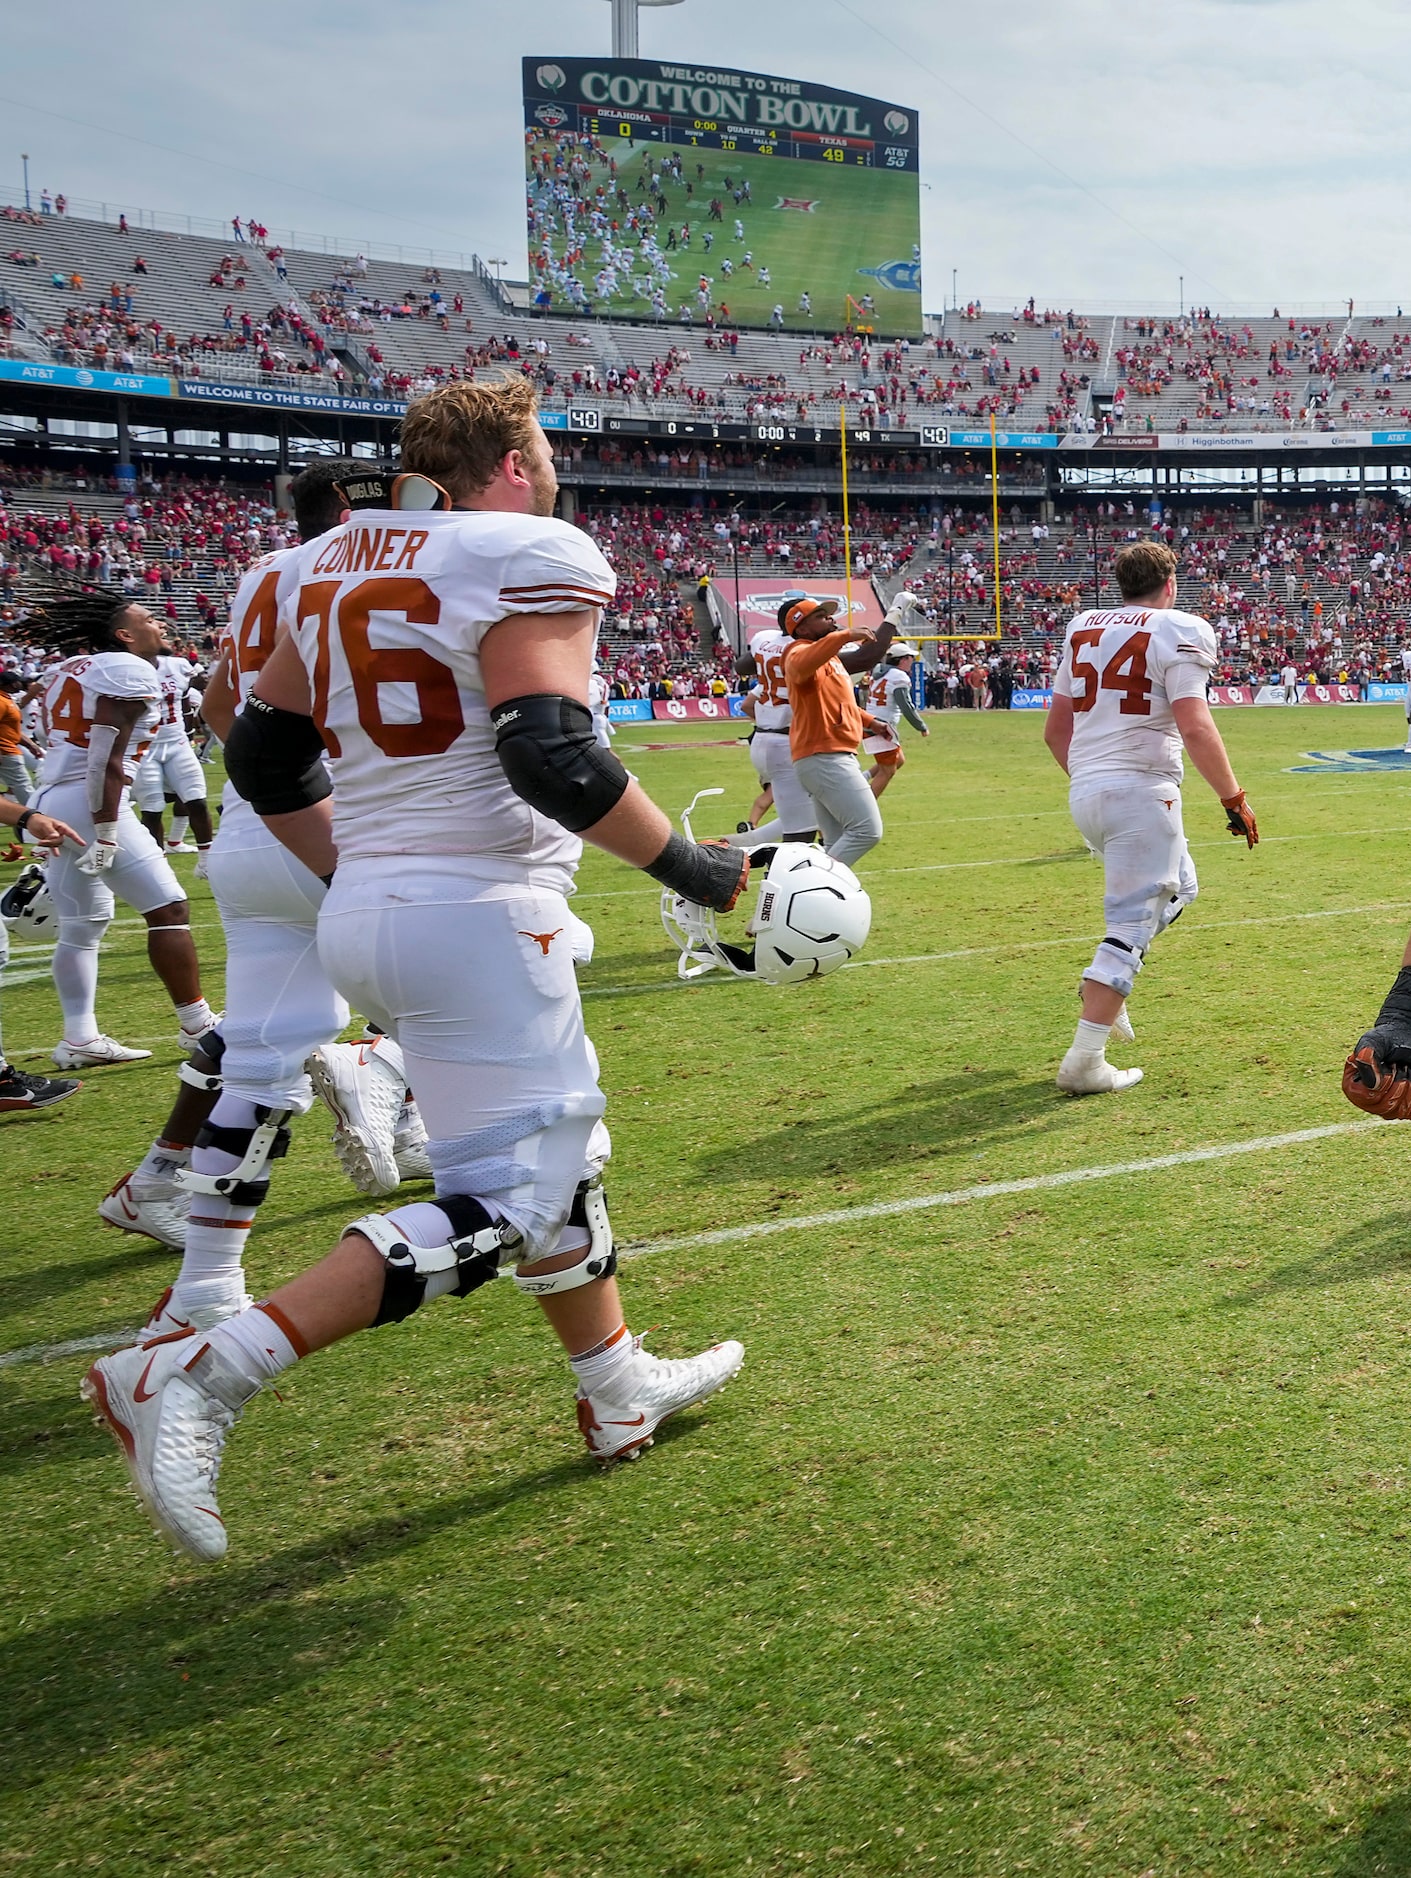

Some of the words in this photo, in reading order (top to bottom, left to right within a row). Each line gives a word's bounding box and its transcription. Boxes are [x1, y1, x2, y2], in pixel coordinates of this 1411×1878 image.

[660, 65, 741, 88] WELCOME
[744, 77, 766, 91] TO
[770, 81, 801, 95] THE
[581, 72, 749, 122] COTTON
[756, 95, 871, 136] BOWL
[597, 108, 652, 123] OKLAHOMA
[619, 122, 631, 137] 0
[693, 120, 717, 131] 0:00
[727, 125, 766, 137] QUARTER
[768, 130, 776, 139] 4
[690, 136, 698, 146] 1
[721, 140, 735, 150] 10
[819, 136, 848, 147] TEXAS
[758, 144, 773, 155] 42
[822, 148, 844, 162] 49
[884, 146, 910, 157] AT&T
[886, 157, 905, 167] 5G
[22, 366, 55, 379] AT&T
[113, 377, 144, 389] AT&T
[184, 384, 252, 400] WELCOME
[256, 391, 273, 402] TO
[274, 393, 301, 405] THE
[303, 396, 340, 408] STATE
[342, 400, 370, 411] FAIR
[373, 402, 390, 413] OF
[392, 403, 407, 414] TE
[572, 411, 597, 428] 40
[610, 421, 621, 430] OU
[667, 422, 677, 434] 0
[757, 425, 785, 440] 0:00
[789, 432, 796, 440] 4
[855, 431, 871, 442] 49
[880, 433, 890, 441] TX
[924, 427, 946, 444] 40
[962, 435, 984, 443] AT&T
[1021, 436, 1043, 444] AT&T
[1386, 433, 1407, 442] AT&T
[1192, 438, 1254, 447] Higginbotham
[312, 528, 429, 575] CONNER
[1084, 610, 1154, 627] HUTSON
[298, 577, 466, 759] 76
[1070, 628, 1152, 716] 54
[1227, 687, 1243, 704] OU
[1270, 691, 1285, 700] SR
[1314, 685, 1331, 701] OU
[1384, 686, 1406, 696] AT&T
[608, 704, 638, 716] AT&T
[666, 700, 687, 718] OU
[698, 699, 719, 717] OU
[761, 892, 775, 922] HORNS
